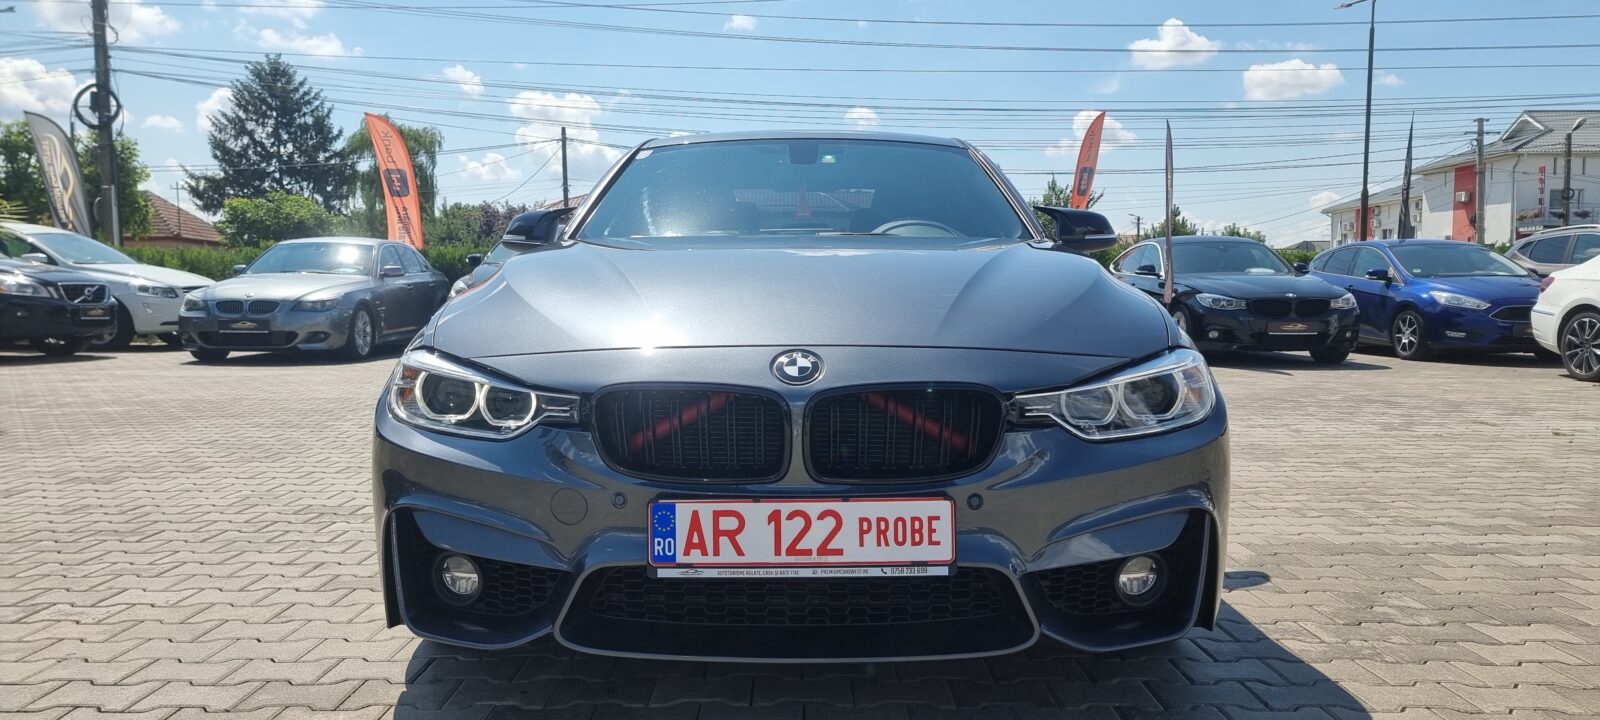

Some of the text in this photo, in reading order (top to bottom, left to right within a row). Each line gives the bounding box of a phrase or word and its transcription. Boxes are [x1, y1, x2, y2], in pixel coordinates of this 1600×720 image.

[654, 538, 674, 556] RO
[683, 509, 941, 556] AR 122 PROBE
